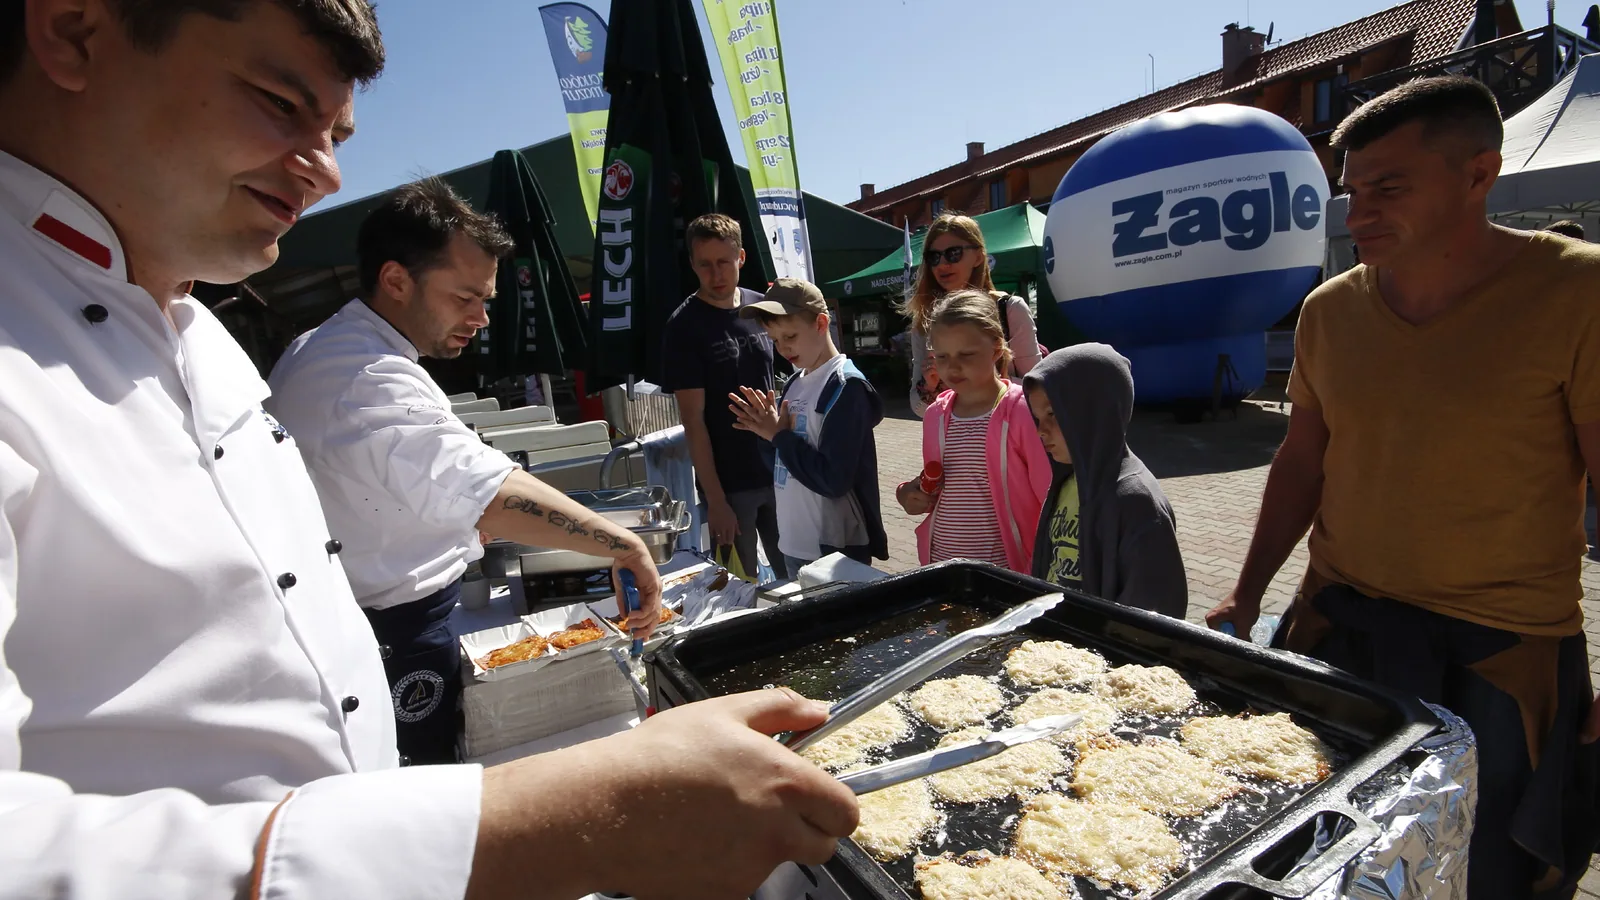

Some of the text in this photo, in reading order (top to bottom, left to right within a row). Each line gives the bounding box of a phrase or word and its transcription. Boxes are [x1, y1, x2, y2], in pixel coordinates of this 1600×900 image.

[1165, 172, 1267, 195] magazyn sportów wodnych
[600, 207, 633, 331] LECH
[1114, 250, 1183, 268] www.zagle.com.pl
